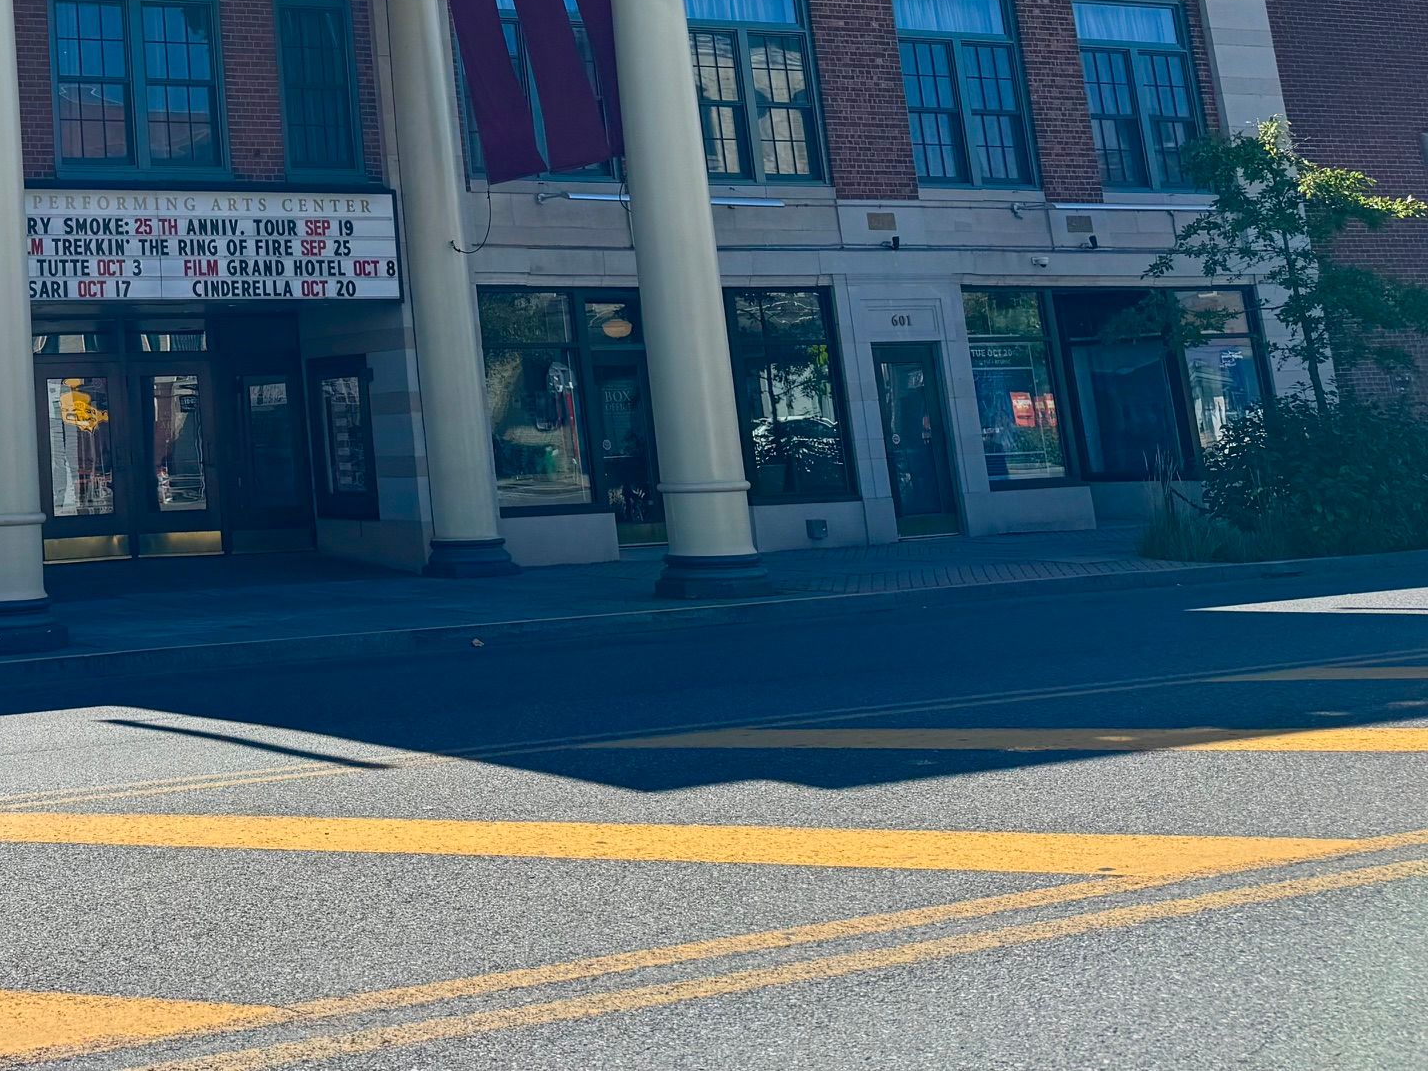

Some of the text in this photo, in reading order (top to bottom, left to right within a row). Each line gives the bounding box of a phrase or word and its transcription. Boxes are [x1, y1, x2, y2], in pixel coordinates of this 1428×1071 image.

[33, 195, 372, 213] PERFORMING ARTS CENTER
[63, 217, 130, 235] SMOKE:
[134, 218, 153, 235] 25
[158, 218, 179, 235] TH
[186, 218, 245, 236] ANNIV.
[253, 219, 298, 236] TOUR
[305, 219, 331, 236] SEP
[338, 219, 354, 236] 19
[52, 238, 131, 256] TREKKIN'
[138, 239, 169, 256] THE
[178, 239, 218, 256] RING
[226, 239, 247, 256] OF
[255, 239, 294, 256] FIRE
[301, 240, 327, 256] SEP
[333, 240, 352, 256] 25
[36, 259, 142, 277] TUTTE OCT 3
[183, 259, 396, 277] FILM GRAND HOTEL OCT 8
[29, 280, 131, 298] SARI OCT 17
[192, 279, 357, 297] CINDERELLA OCT 20
[891, 314, 912, 327] 601
[604, 390, 631, 402] BOX
